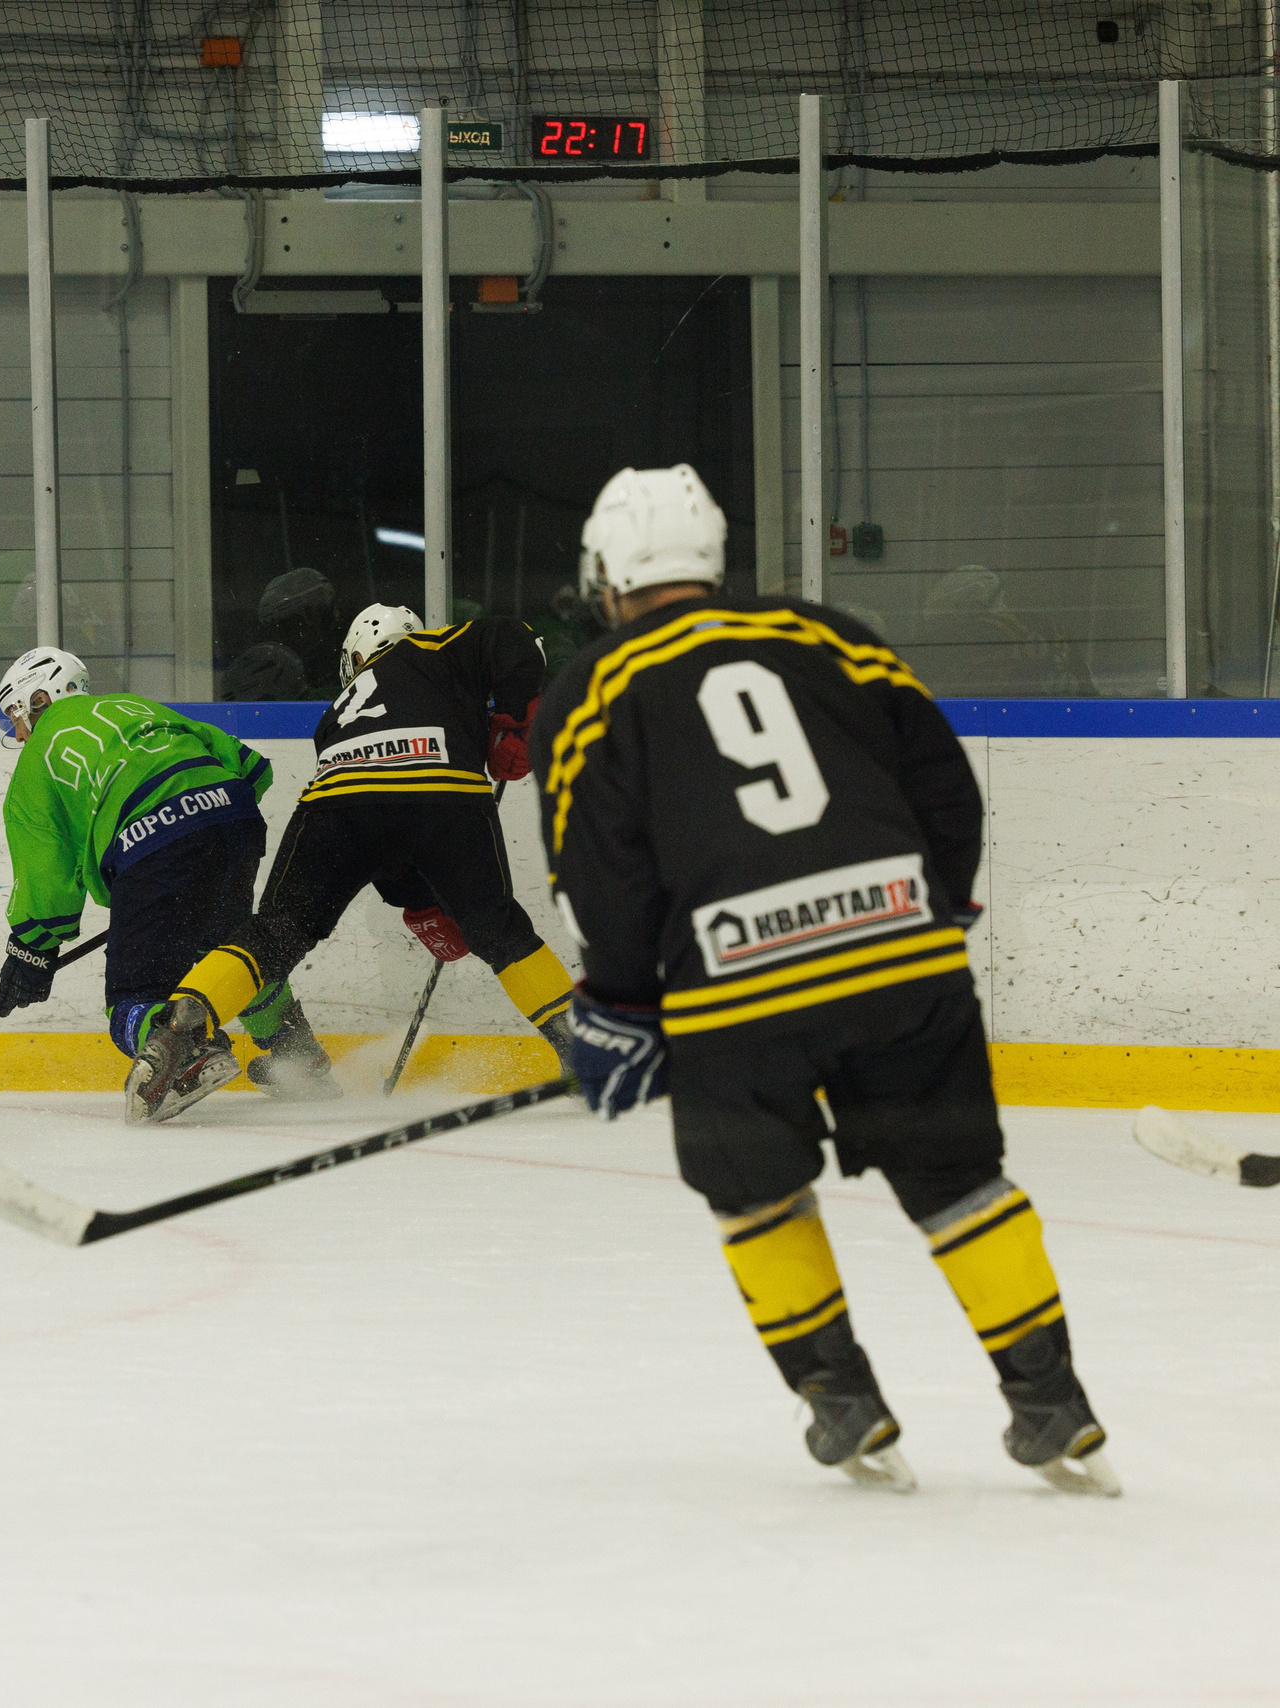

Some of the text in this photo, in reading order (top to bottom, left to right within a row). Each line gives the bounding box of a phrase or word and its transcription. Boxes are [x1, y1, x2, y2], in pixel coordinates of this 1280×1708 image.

[447, 131, 491, 146] ЫХОД
[540, 121, 646, 155] 22:17
[696, 660, 830, 835] 9
[6, 940, 50, 970] Reebok
